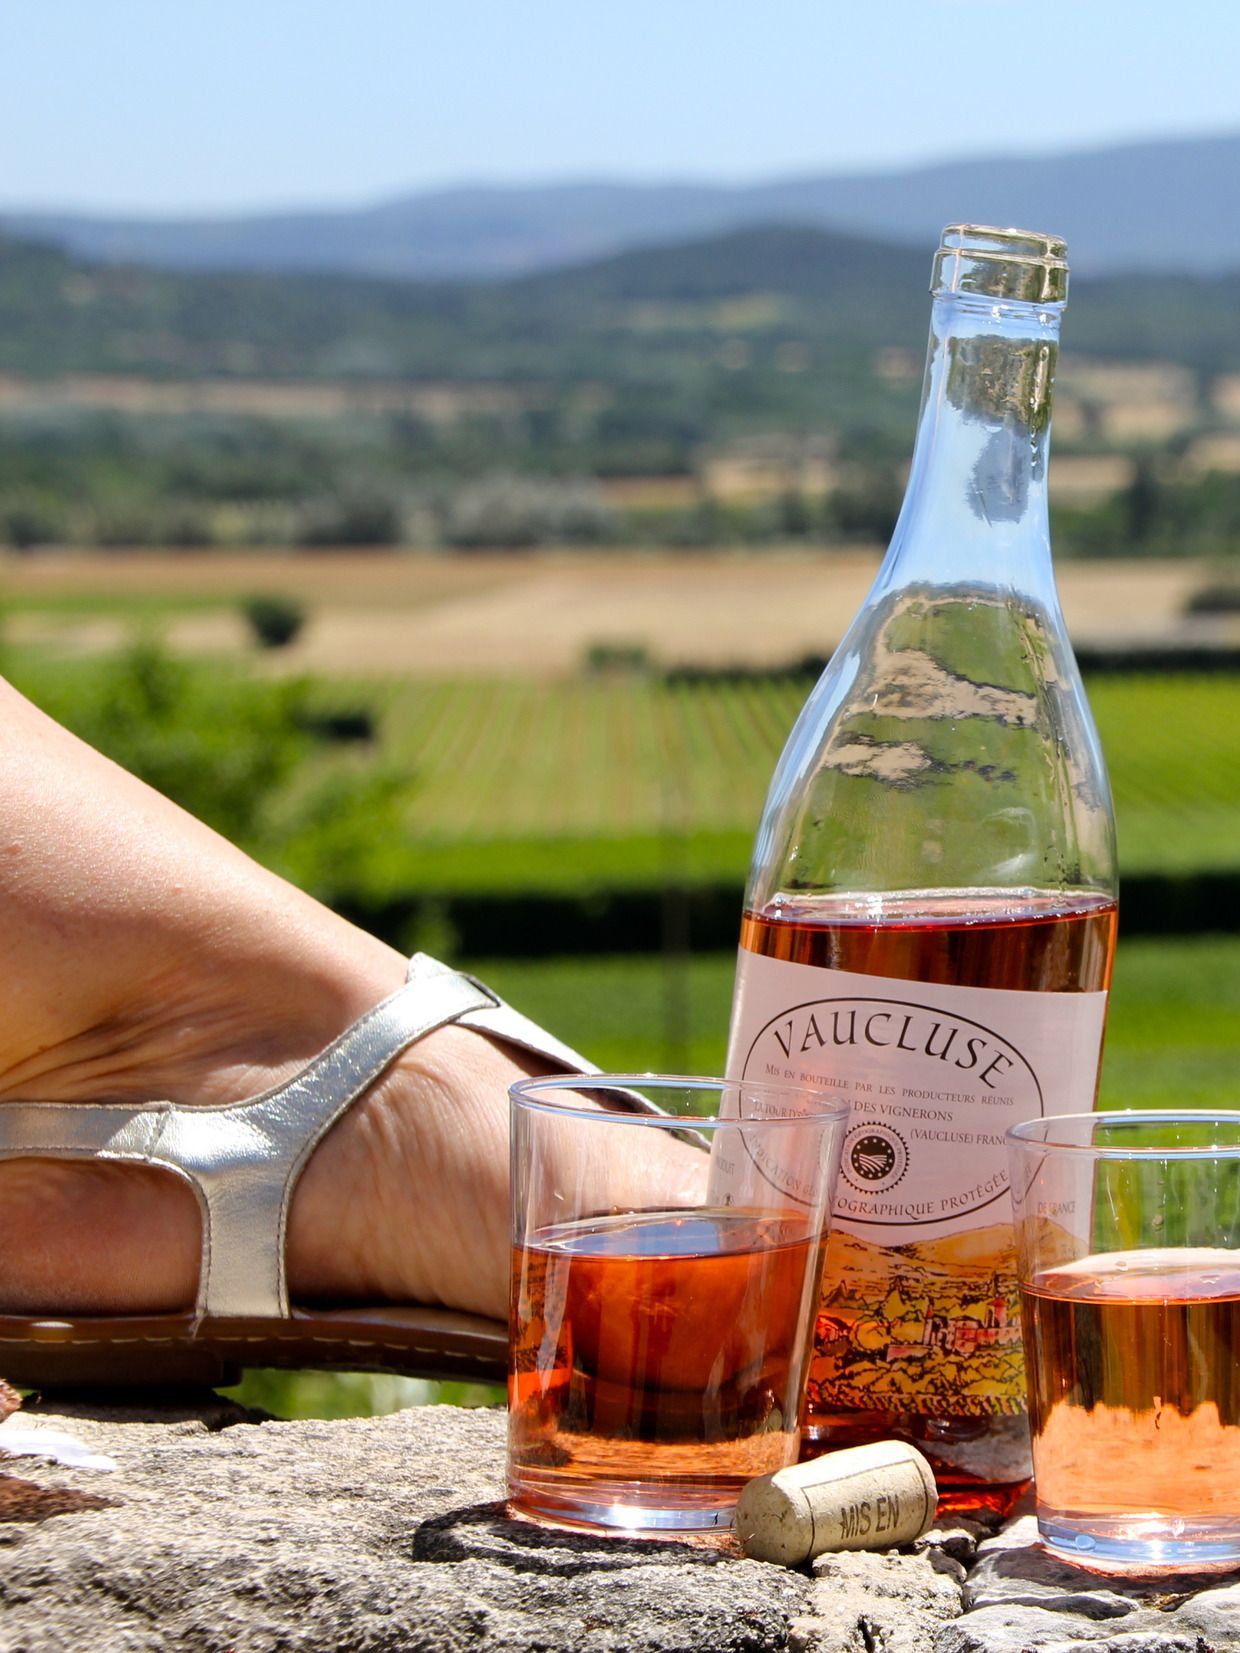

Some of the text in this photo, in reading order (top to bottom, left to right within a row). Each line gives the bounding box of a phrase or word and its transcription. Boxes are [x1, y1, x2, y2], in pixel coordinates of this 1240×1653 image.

[773, 1010, 1014, 1089] VAUCLUSE
[784, 1070, 796, 1080] EN
[800, 1072, 849, 1089] BOUTEILLE
[855, 1081, 873, 1093] PAR
[880, 1085, 896, 1096] LES
[902, 1087, 976, 1104] PRODUCTEURS
[854, 1100, 953, 1121] DES VIGNERONS
[910, 1128, 974, 1145] (VAUCLUSE)
[838, 1494, 900, 1540] MIS EN
